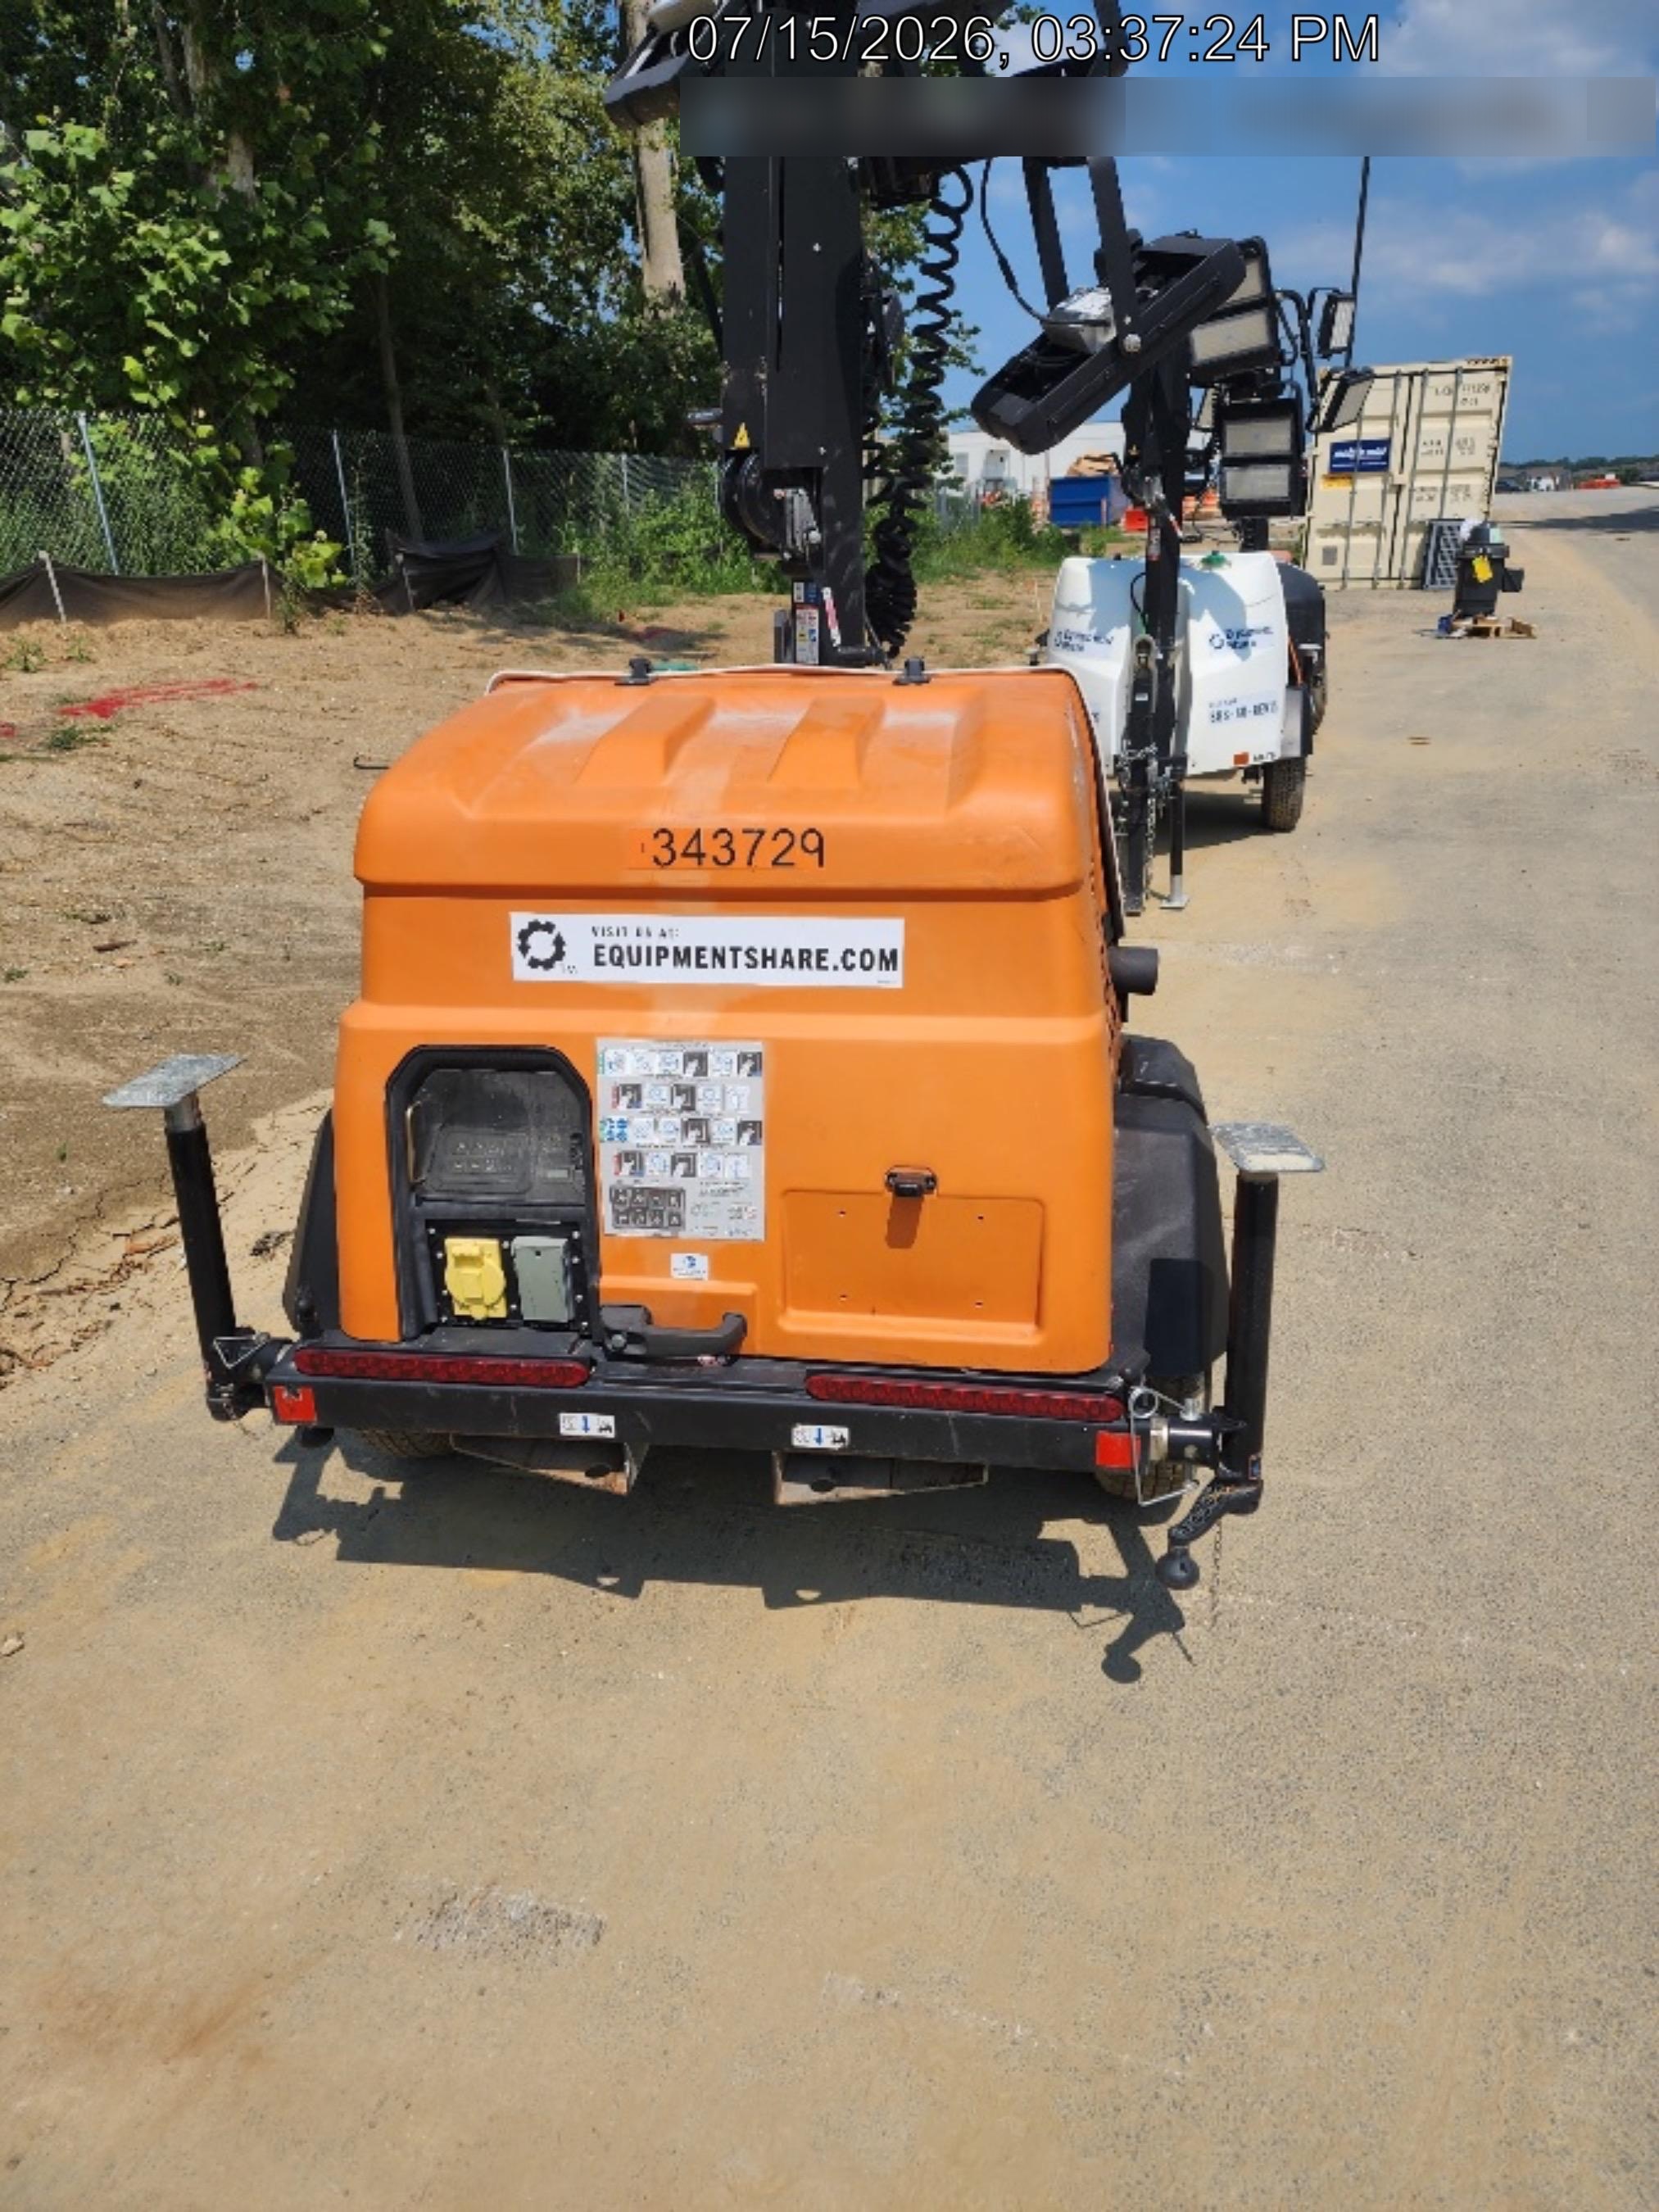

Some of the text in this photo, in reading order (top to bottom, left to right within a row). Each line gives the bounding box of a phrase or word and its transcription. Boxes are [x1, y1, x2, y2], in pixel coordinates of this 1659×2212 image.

[652, 827, 824, 868] 343729
[591, 926, 628, 938] VISIT
[593, 944, 898, 972] EQUIPMENTSHARE.COM
